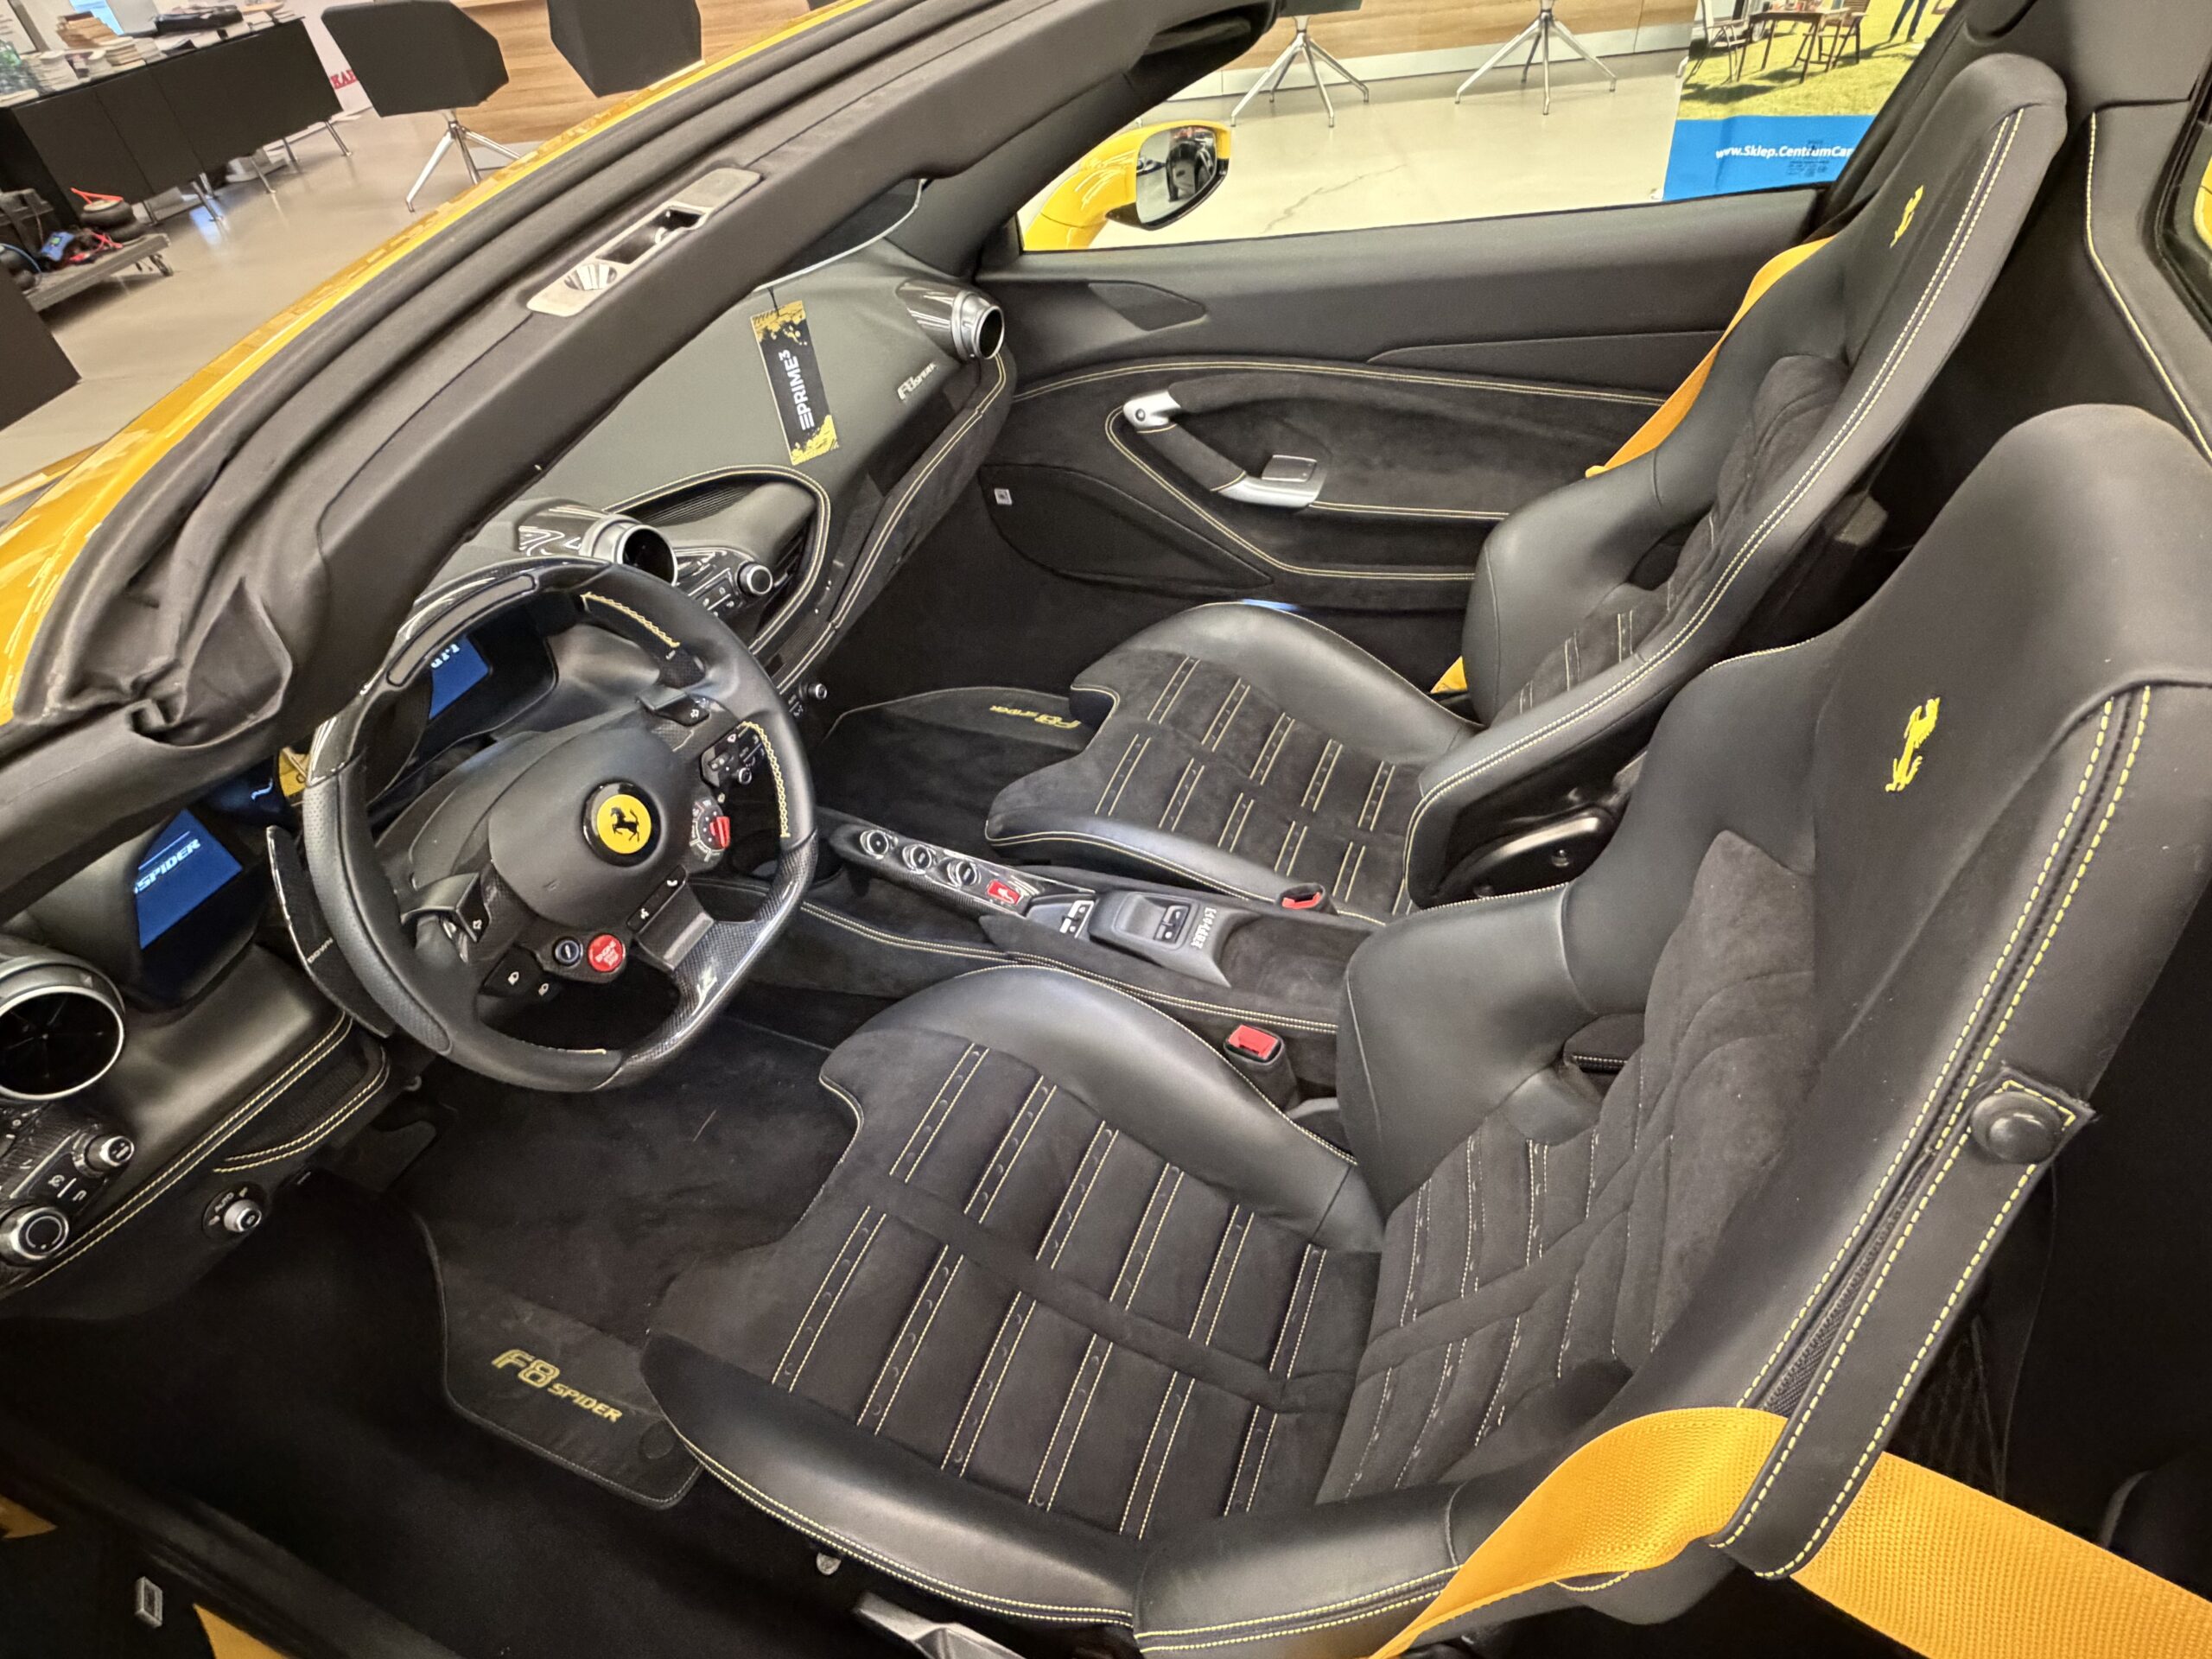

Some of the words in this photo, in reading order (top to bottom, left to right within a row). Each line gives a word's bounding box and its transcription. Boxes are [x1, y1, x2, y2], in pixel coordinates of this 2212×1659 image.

[137, 839, 201, 892] SPIDER
[307, 938, 334, 963] DOWN
[492, 1350, 561, 1388] F8
[547, 1383, 622, 1422] SPIDER
